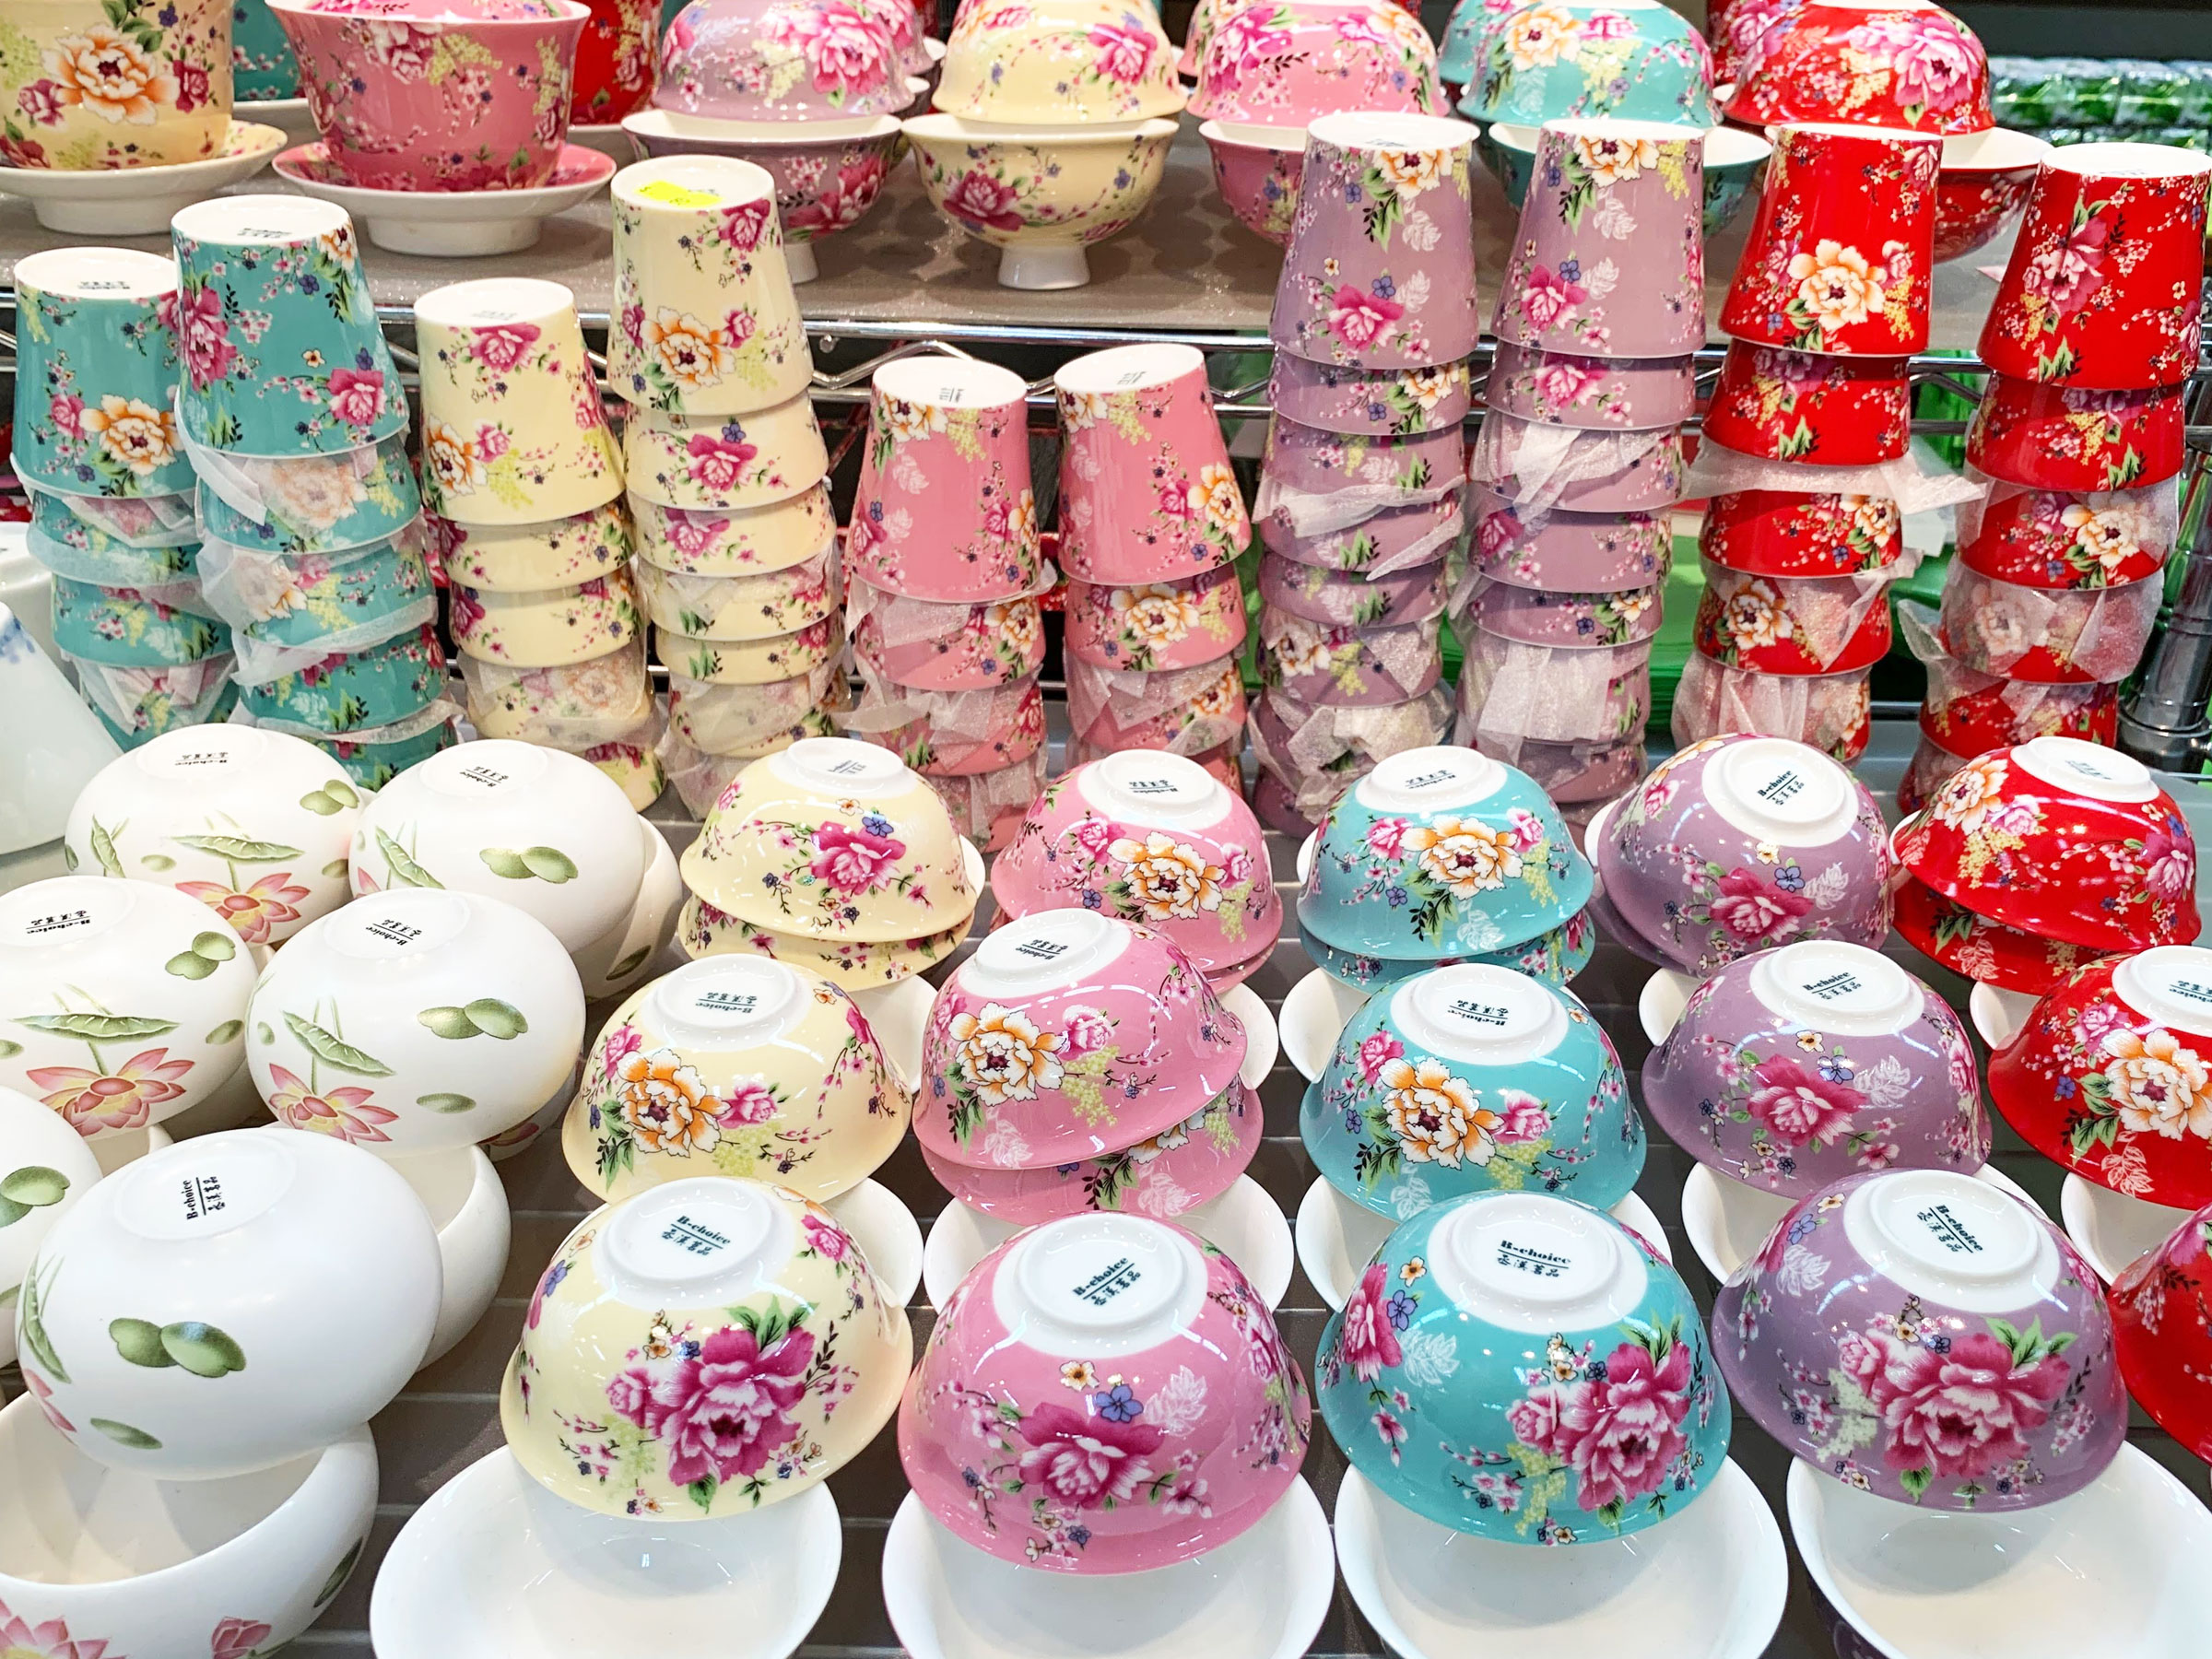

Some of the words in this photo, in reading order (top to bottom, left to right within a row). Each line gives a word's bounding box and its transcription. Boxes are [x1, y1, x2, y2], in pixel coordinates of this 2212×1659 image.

[1757, 771, 1793, 797] B-choice
[27, 919, 90, 935] B-choice
[365, 926, 408, 946] B-choice
[1015, 947, 1055, 960] B-choice
[1802, 972, 1851, 991] B-choice
[695, 1002, 754, 1014] B-choice
[1447, 1009, 1506, 1026] B-choice
[182, 1180, 198, 1220] B-choice
[677, 1215, 731, 1245] B-choice
[1935, 1204, 1983, 1252] B-choice
[1500, 1240, 1571, 1265] B-choice
[1072, 1257, 1129, 1297] B-choice
